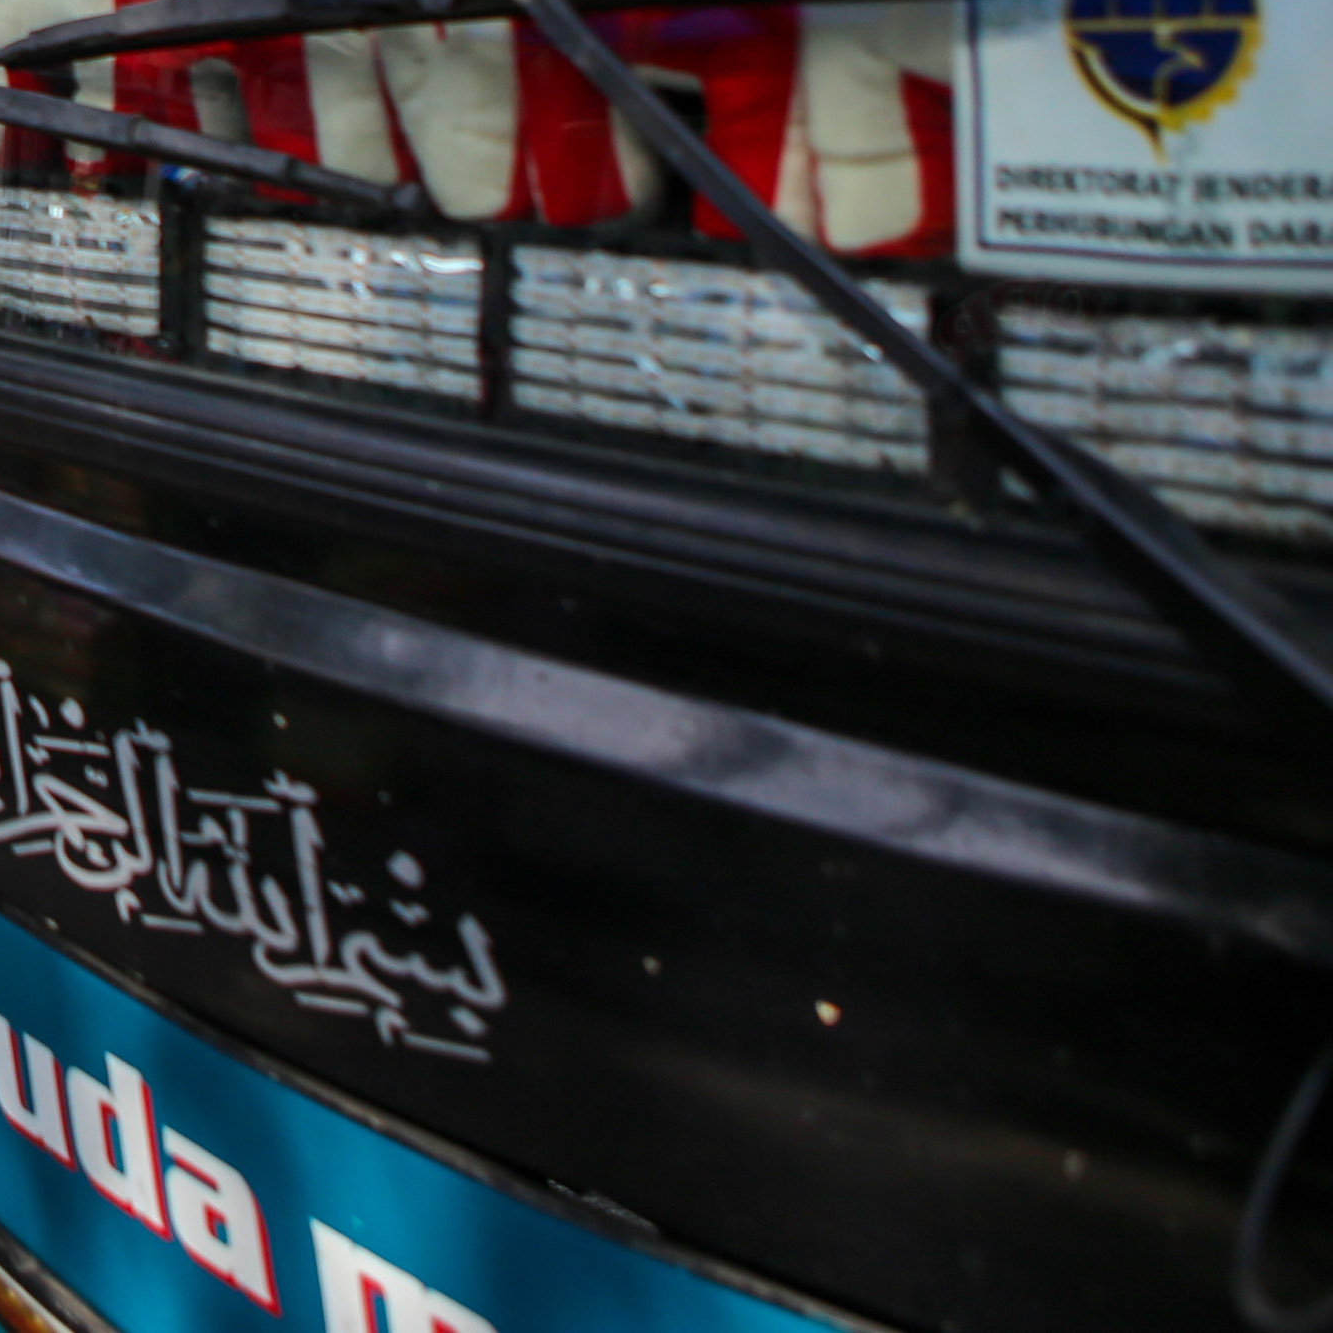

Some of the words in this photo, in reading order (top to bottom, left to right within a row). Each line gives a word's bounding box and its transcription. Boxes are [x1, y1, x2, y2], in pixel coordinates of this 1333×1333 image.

[995, 163, 1178, 201] DIREKTORAT
[1192, 170, 1333, 203] JENDER
[996, 207, 1234, 249] PERHUBUNGAN
[1247, 219, 1333, 248] DAR
